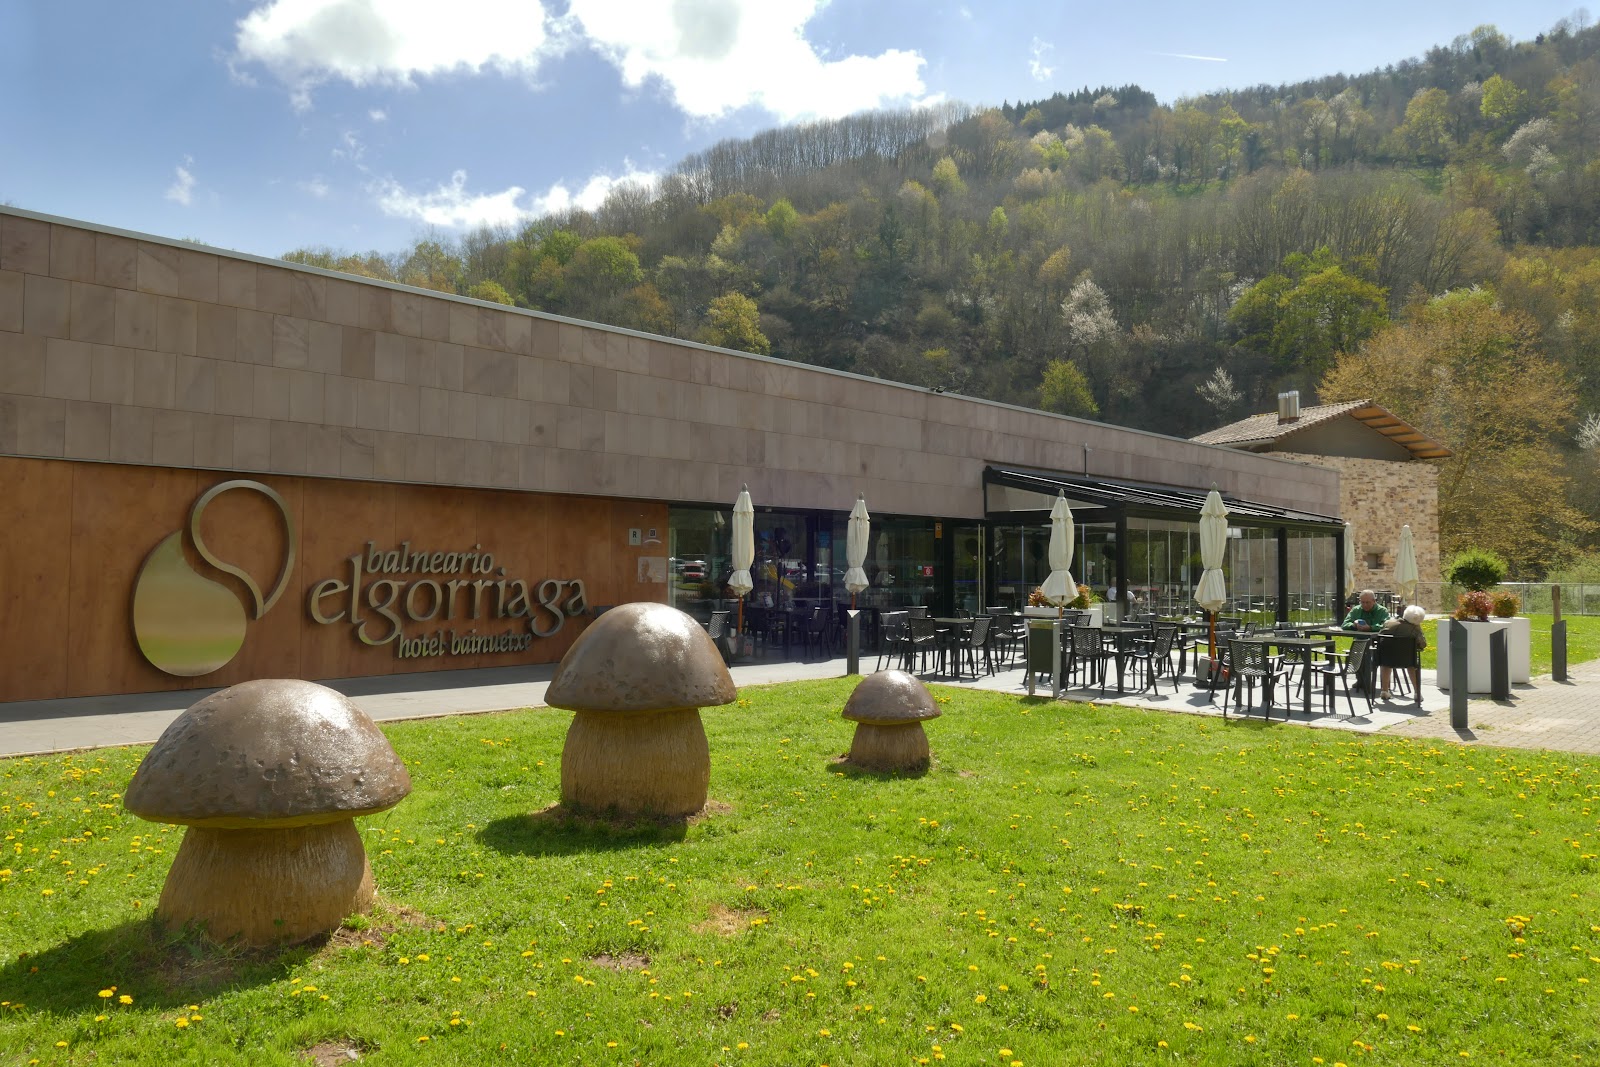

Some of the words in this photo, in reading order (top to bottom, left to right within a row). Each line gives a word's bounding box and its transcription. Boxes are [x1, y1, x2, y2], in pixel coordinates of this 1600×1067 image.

[366, 541, 495, 574] balneario
[311, 554, 588, 645] elgorriaga
[399, 629, 445, 658] hotel
[450, 629, 532, 655] bainuetxe
